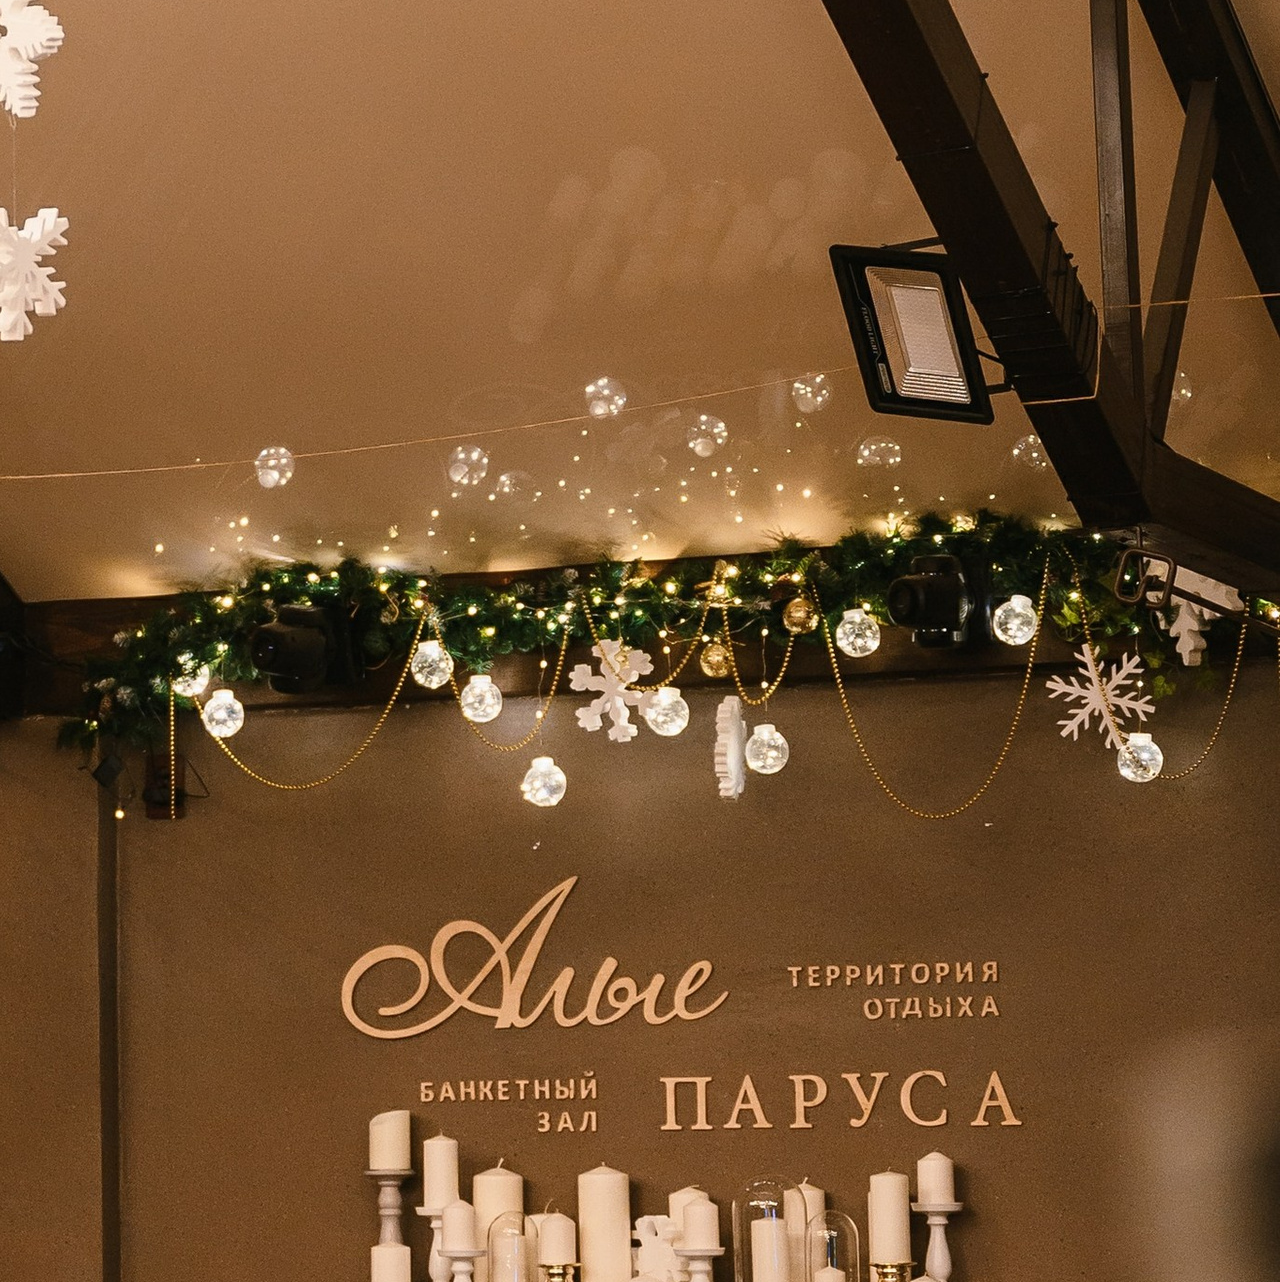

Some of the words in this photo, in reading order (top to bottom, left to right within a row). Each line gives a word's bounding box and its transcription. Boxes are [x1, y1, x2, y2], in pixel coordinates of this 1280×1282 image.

[340, 875, 729, 1040] Алые
[787, 960, 1000, 988] ТЕРРИТОРИЯ
[862, 995, 1001, 1020] ОТДЫХА
[419, 1070, 599, 1103] БАНКЕТНЫЙ
[659, 1068, 1024, 1132] ПАРУСА
[537, 1110, 599, 1134] ЗАЛ
